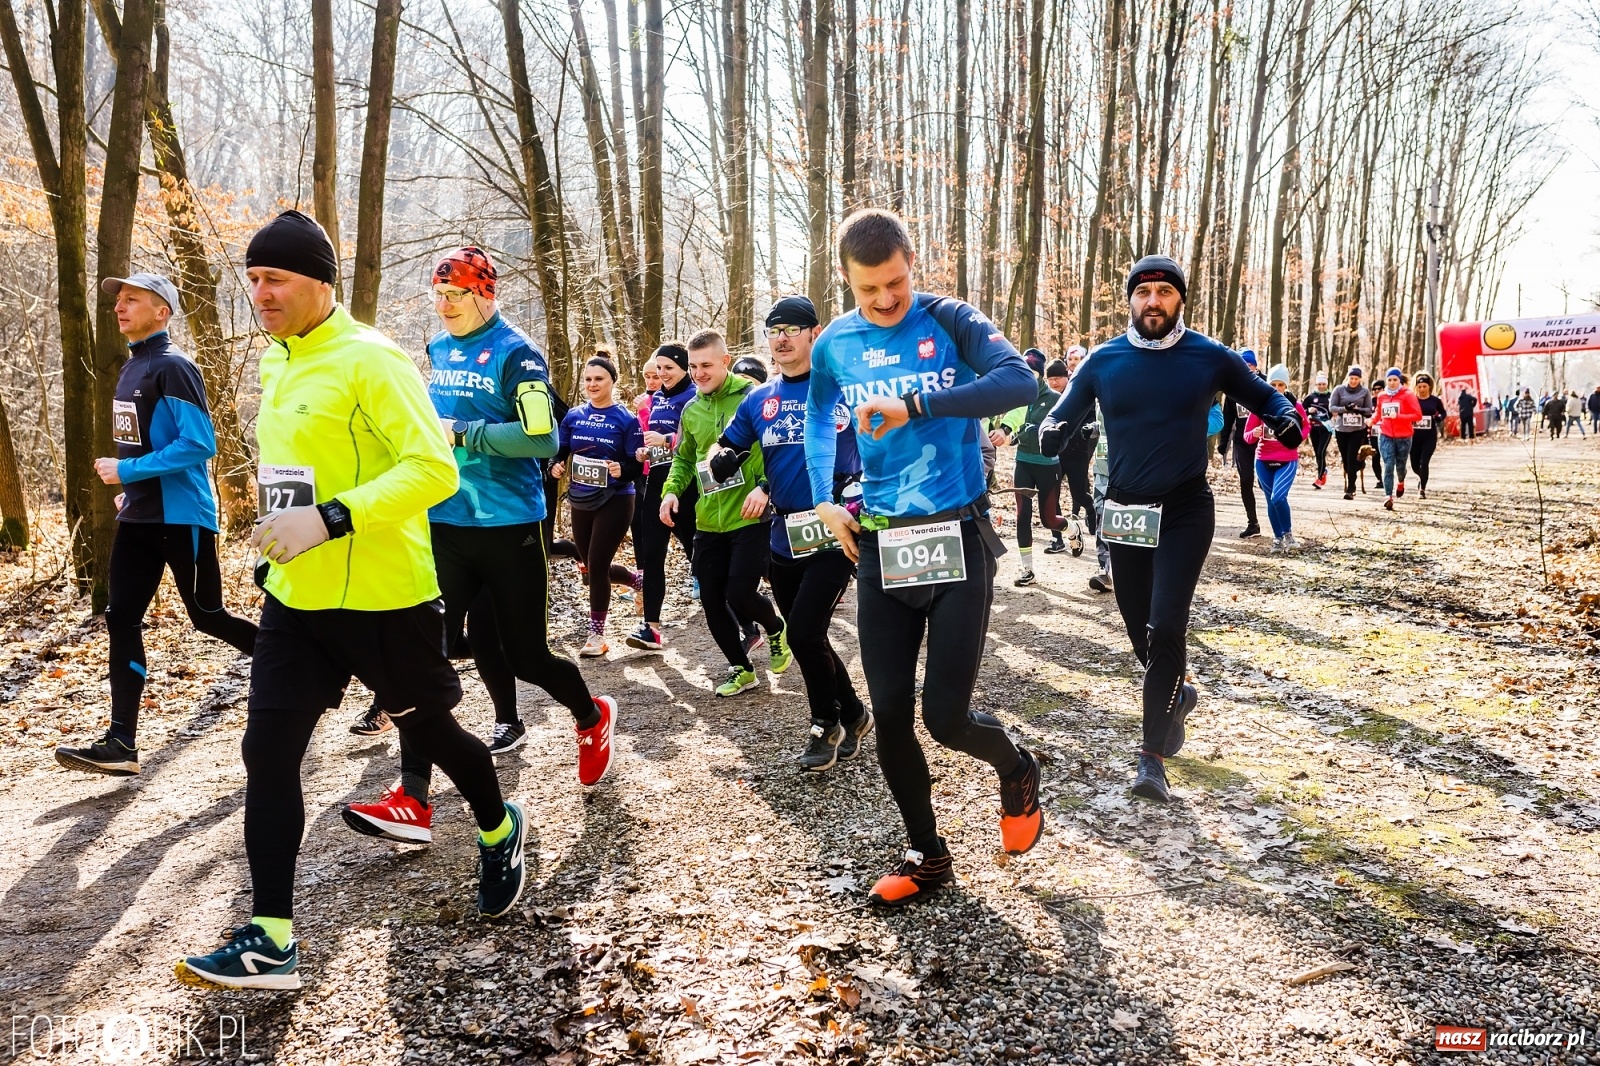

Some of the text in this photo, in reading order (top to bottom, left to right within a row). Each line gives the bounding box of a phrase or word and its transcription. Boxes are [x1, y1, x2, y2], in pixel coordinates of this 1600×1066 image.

[1546, 318, 1574, 326] BIEG
[1523, 326, 1597, 339] TWARDZIELA
[1531, 338, 1589, 349] RACIBÓRZ
[452, 389, 474, 398] TEAM
[115, 414, 132, 432] 088
[575, 420, 616, 430] FEROCITY
[572, 434, 614, 445] RUNNING TEAM
[578, 465, 600, 479] 058
[265, 487, 295, 512] 127
[1111, 511, 1148, 533] 034
[910, 525, 951, 535] Twardziela
[897, 543, 948, 569] 094
